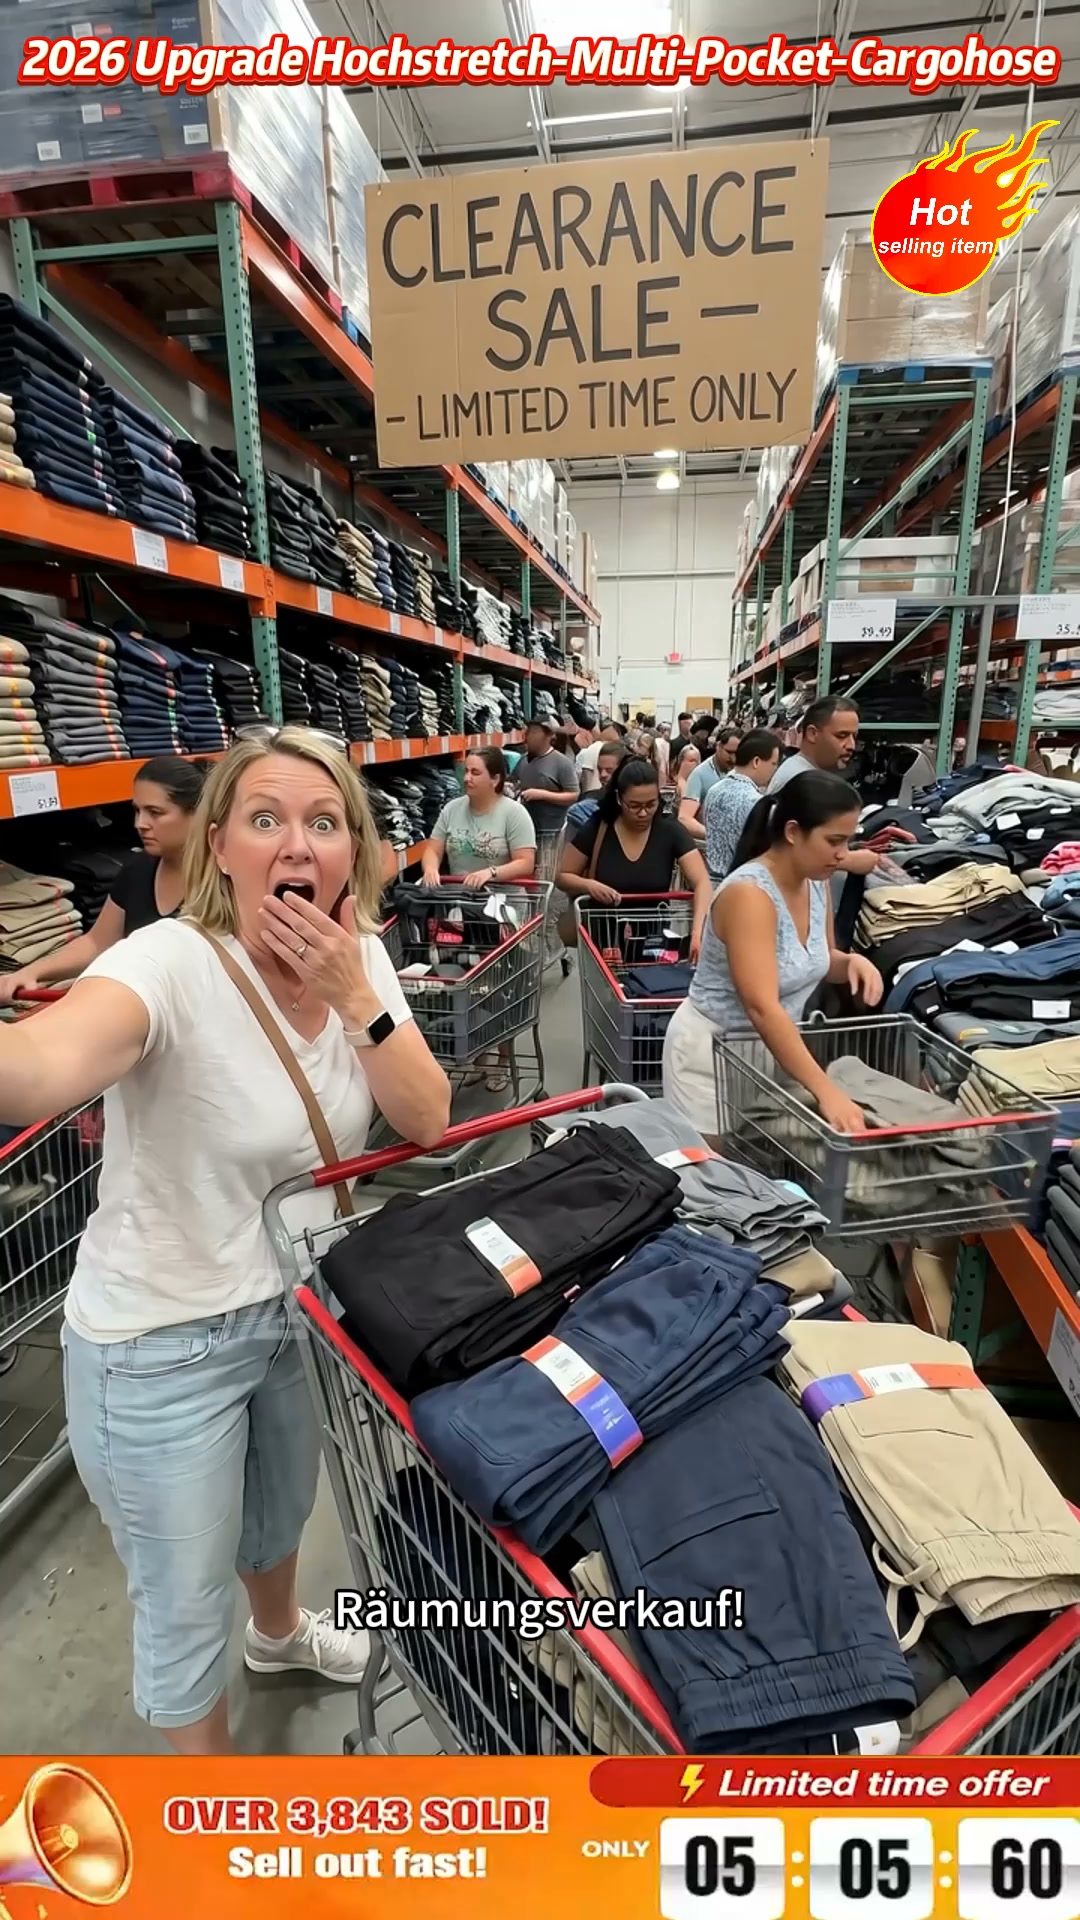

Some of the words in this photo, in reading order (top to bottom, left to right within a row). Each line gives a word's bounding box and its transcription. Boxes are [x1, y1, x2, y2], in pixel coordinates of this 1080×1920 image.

[382, 165, 798, 288] CLEARANCE
[485, 275, 681, 372] SALE
[417, 386, 569, 442] LIMITED
[579, 375, 676, 430] TIME
[690, 368, 798, 424] ONLY
